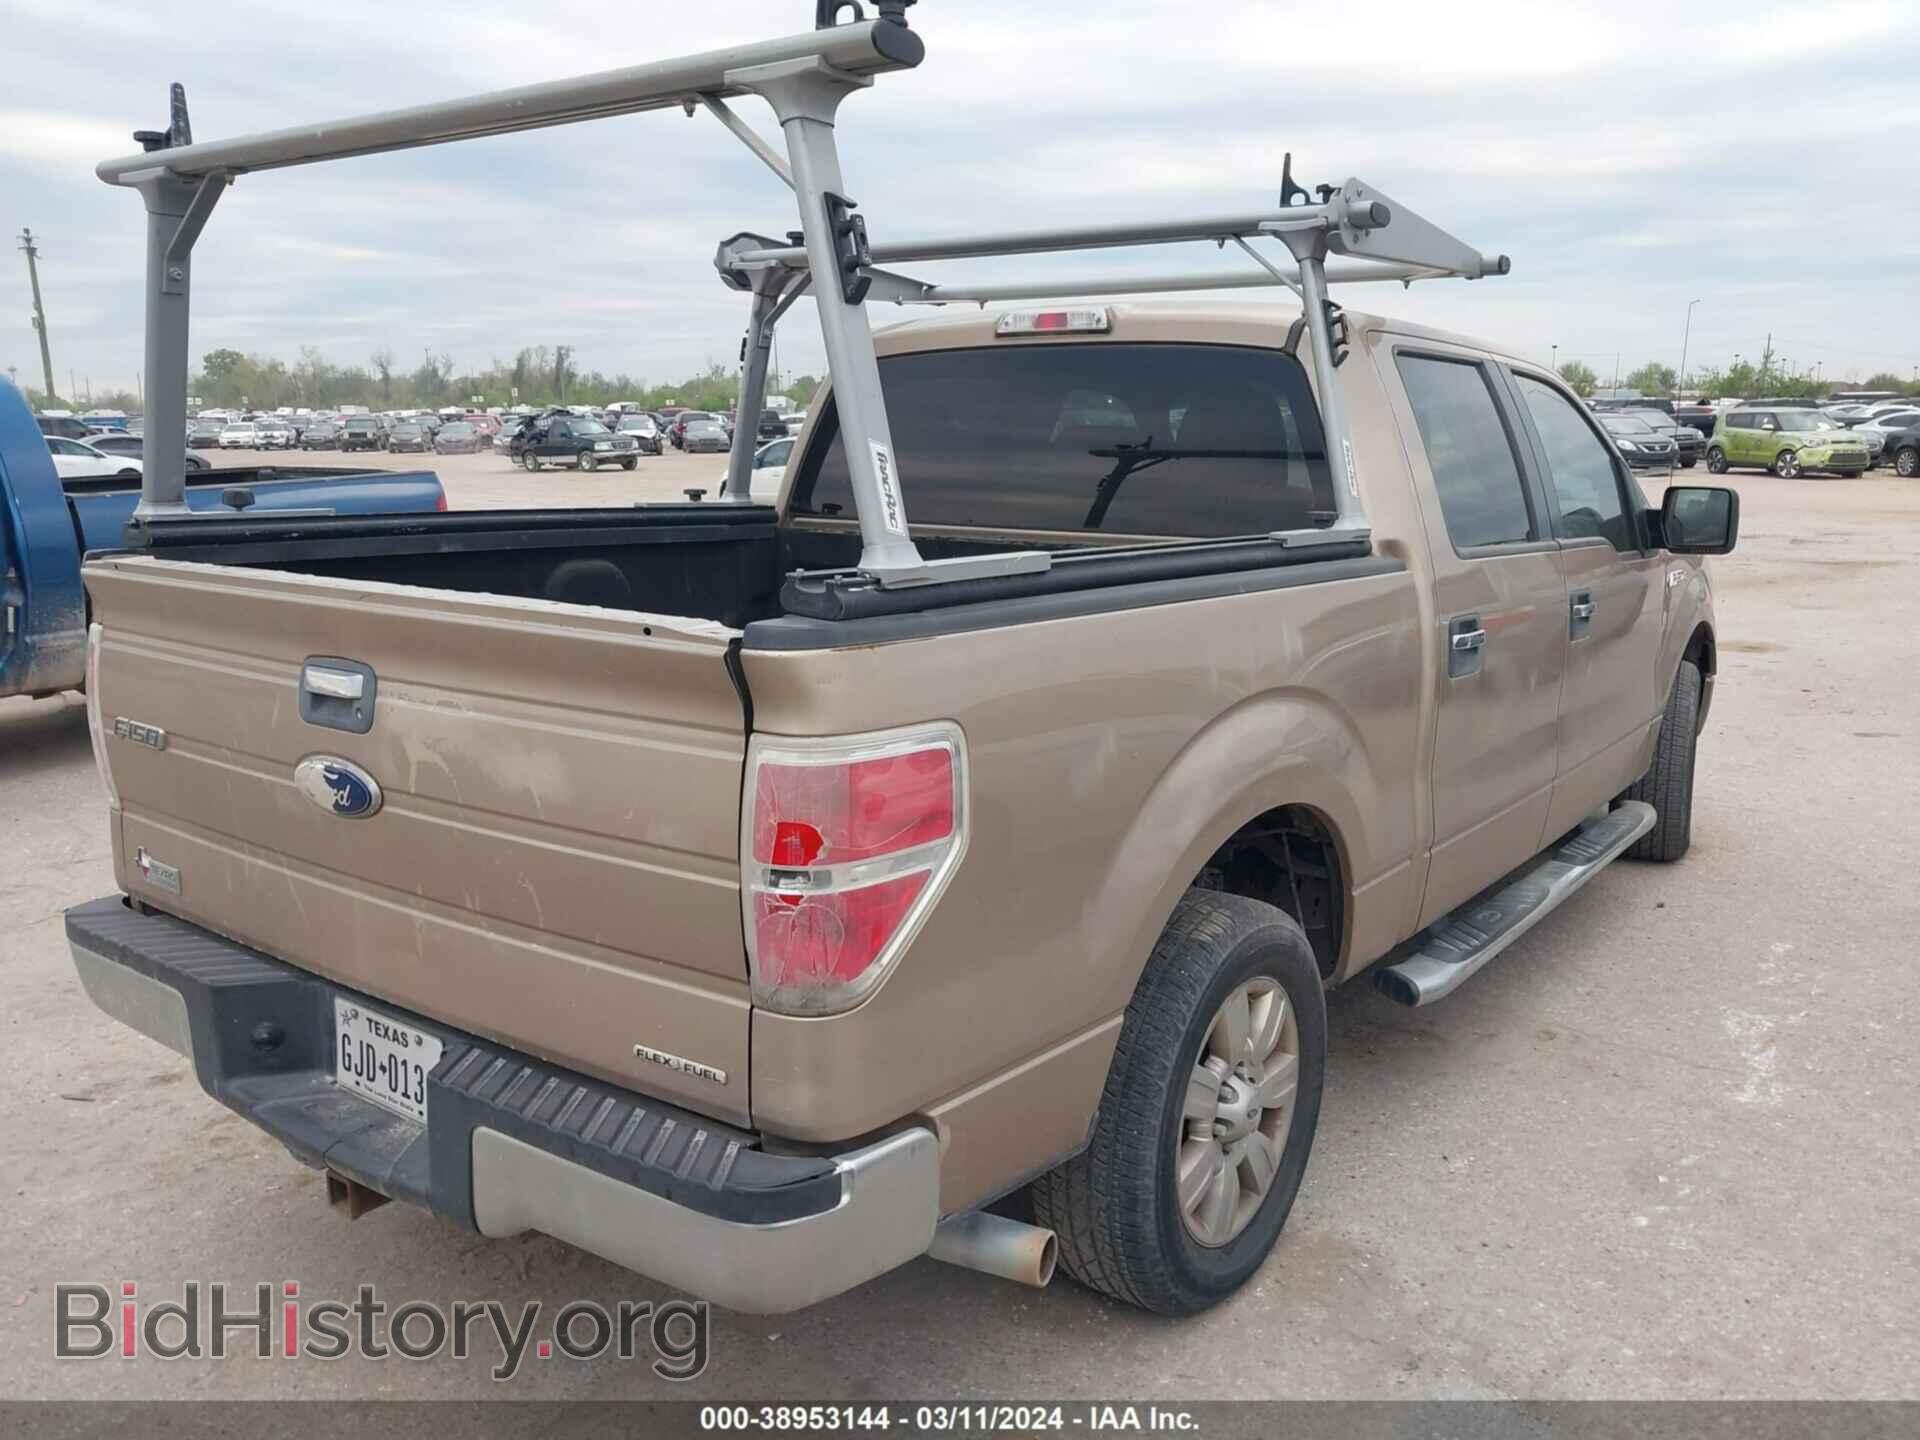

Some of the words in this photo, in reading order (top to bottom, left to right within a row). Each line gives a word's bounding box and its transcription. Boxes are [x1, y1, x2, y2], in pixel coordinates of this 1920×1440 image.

[366, 1016, 409, 1048] TEXAS
[636, 1047, 671, 1065] FLEX
[684, 1063, 722, 1082] FUEL
